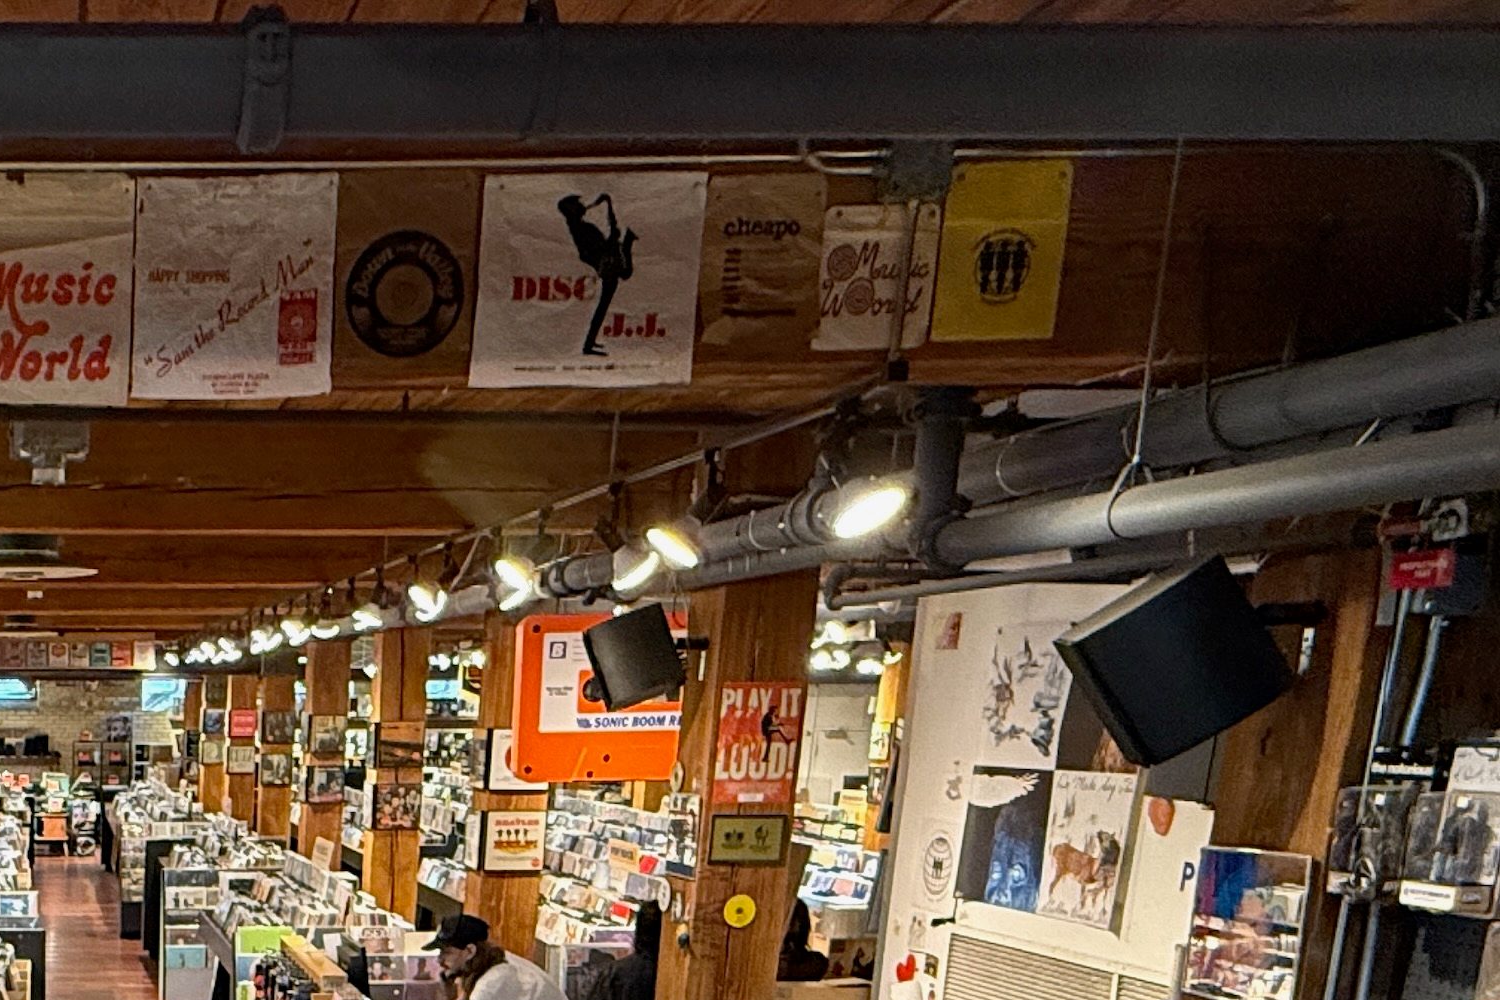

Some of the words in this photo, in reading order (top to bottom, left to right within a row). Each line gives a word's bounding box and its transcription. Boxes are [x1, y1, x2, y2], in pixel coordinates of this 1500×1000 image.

[724, 218, 801, 239] cheapo
[856, 242, 931, 277] Muic
[512, 275, 601, 301] DISC
[603, 313, 666, 338] J.J.
[721, 688, 773, 718] PLAY
[780, 688, 802, 718] IT
[594, 717, 629, 728] SONIC
[632, 715, 665, 727] BOOM
[715, 741, 797, 780] LOUD!
